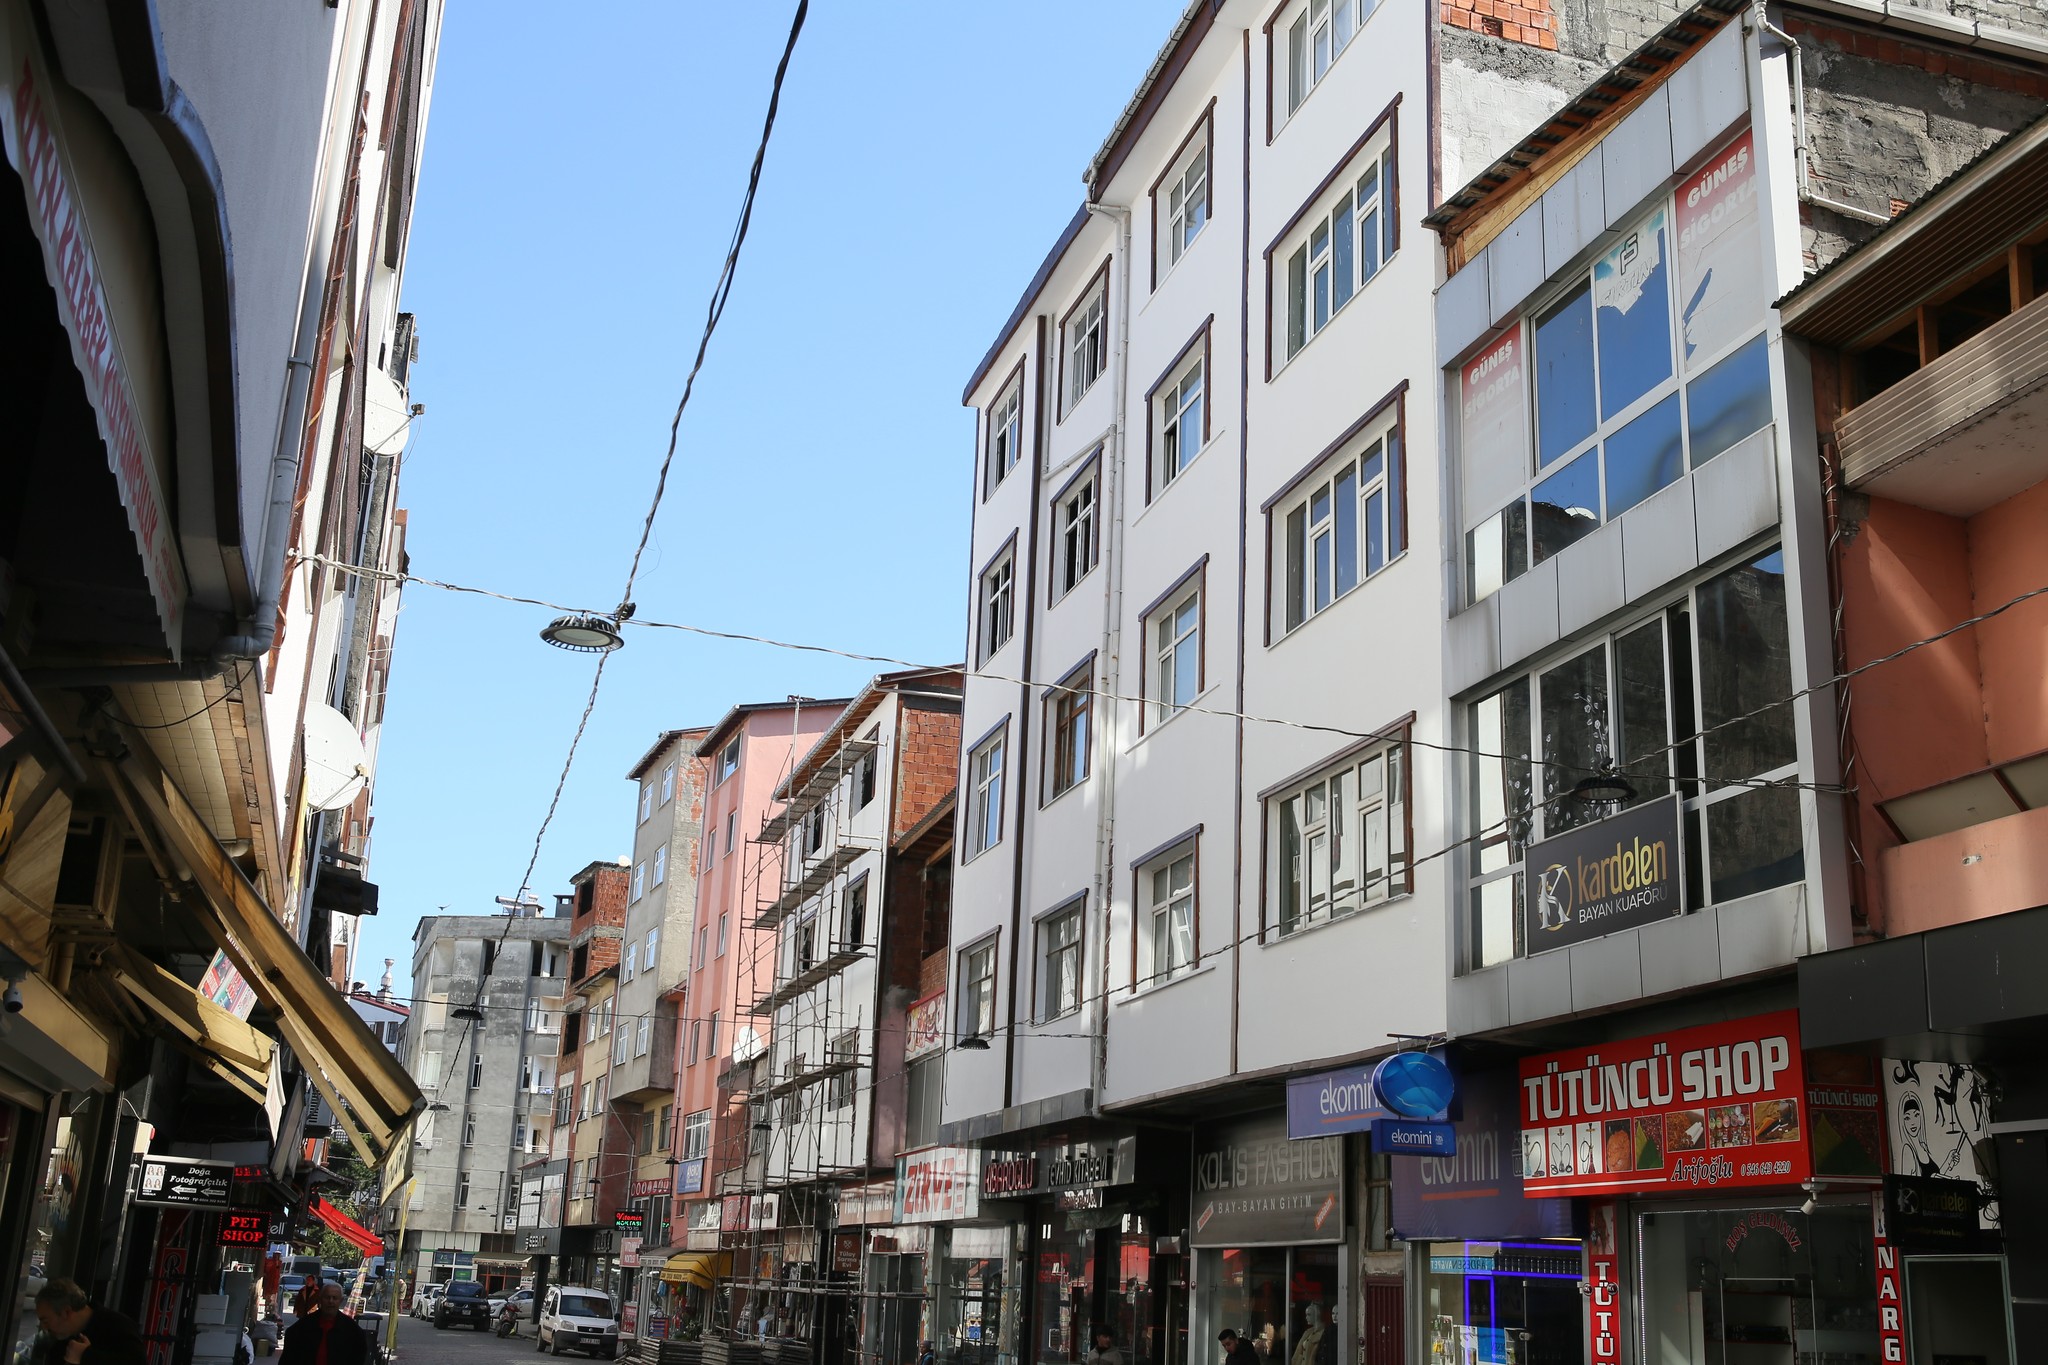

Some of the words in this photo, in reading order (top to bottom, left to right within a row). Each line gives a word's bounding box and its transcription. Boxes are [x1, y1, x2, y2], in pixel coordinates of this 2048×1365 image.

[1687, 145, 1748, 208] GÜNEŞ
[1680, 174, 1757, 250] SİGORTA
[56, 205, 109, 392] KELEBEK
[1469, 339, 1513, 385] GÜNEŞ
[1463, 365, 1520, 420] SİGORTA
[1577, 836, 1668, 905] kardelen
[1578, 900, 1614, 924] BAYAN
[1615, 882, 1668, 914] KUAFÖRÜ
[1320, 1074, 1382, 1115] ekomin
[1523, 1041, 1674, 1122] TÜTÜNCÜ
[1679, 1036, 1791, 1102] SHOP
[1808, 1088, 1852, 1107] TÜTÜNCÜ
[1852, 1093, 1879, 1107] SHOP
[1391, 1129, 1432, 1145] ekomini
[169, 1174, 228, 1187] Fotoğrafçılık
[188, 1167, 211, 1177] Doğa
[1255, 1136, 1339, 1186] FASHION
[1671, 1154, 1734, 1185] Arifoğlu
[903, 1156, 956, 1216] ZİRVE
[229, 1216, 261, 1229] PET
[1218, 1201, 1277, 1214] BAY-BAYAN
[222, 1230, 264, 1243] SHOP
[1725, 1219, 1748, 1253] HOŞ
[1748, 1211, 1802, 1253] GELDİNİZ
